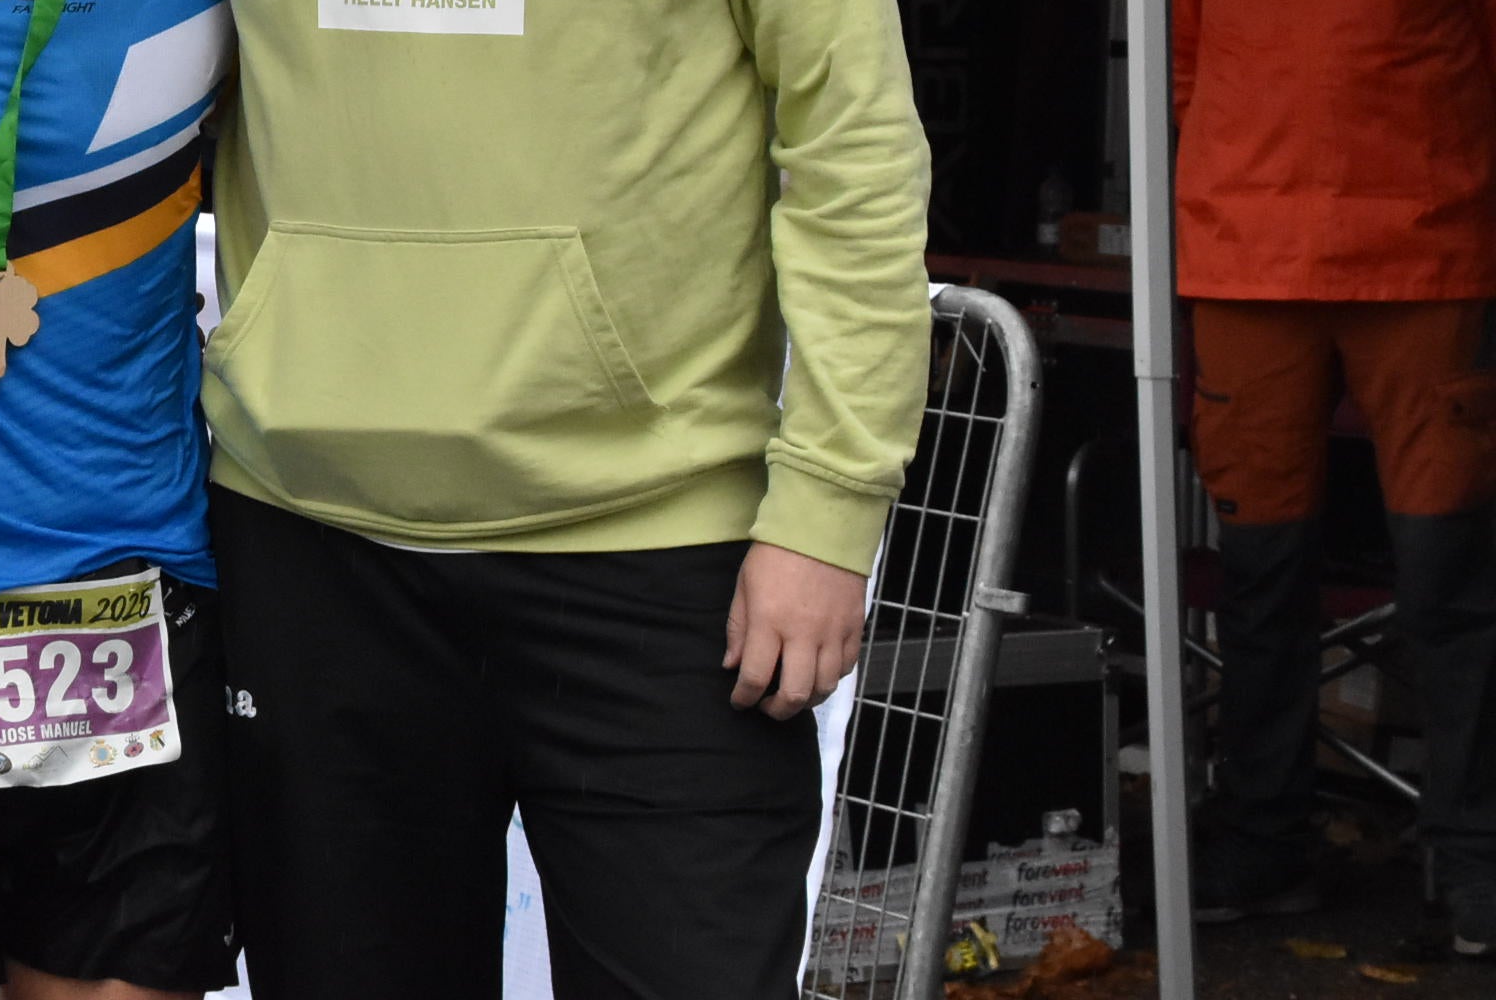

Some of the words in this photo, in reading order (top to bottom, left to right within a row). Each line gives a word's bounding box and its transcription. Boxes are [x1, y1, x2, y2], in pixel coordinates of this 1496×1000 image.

[88, 588, 152, 624] 2025
[40, 720, 92, 741] MANUEL
[1016, 858, 1091, 884] forevent
